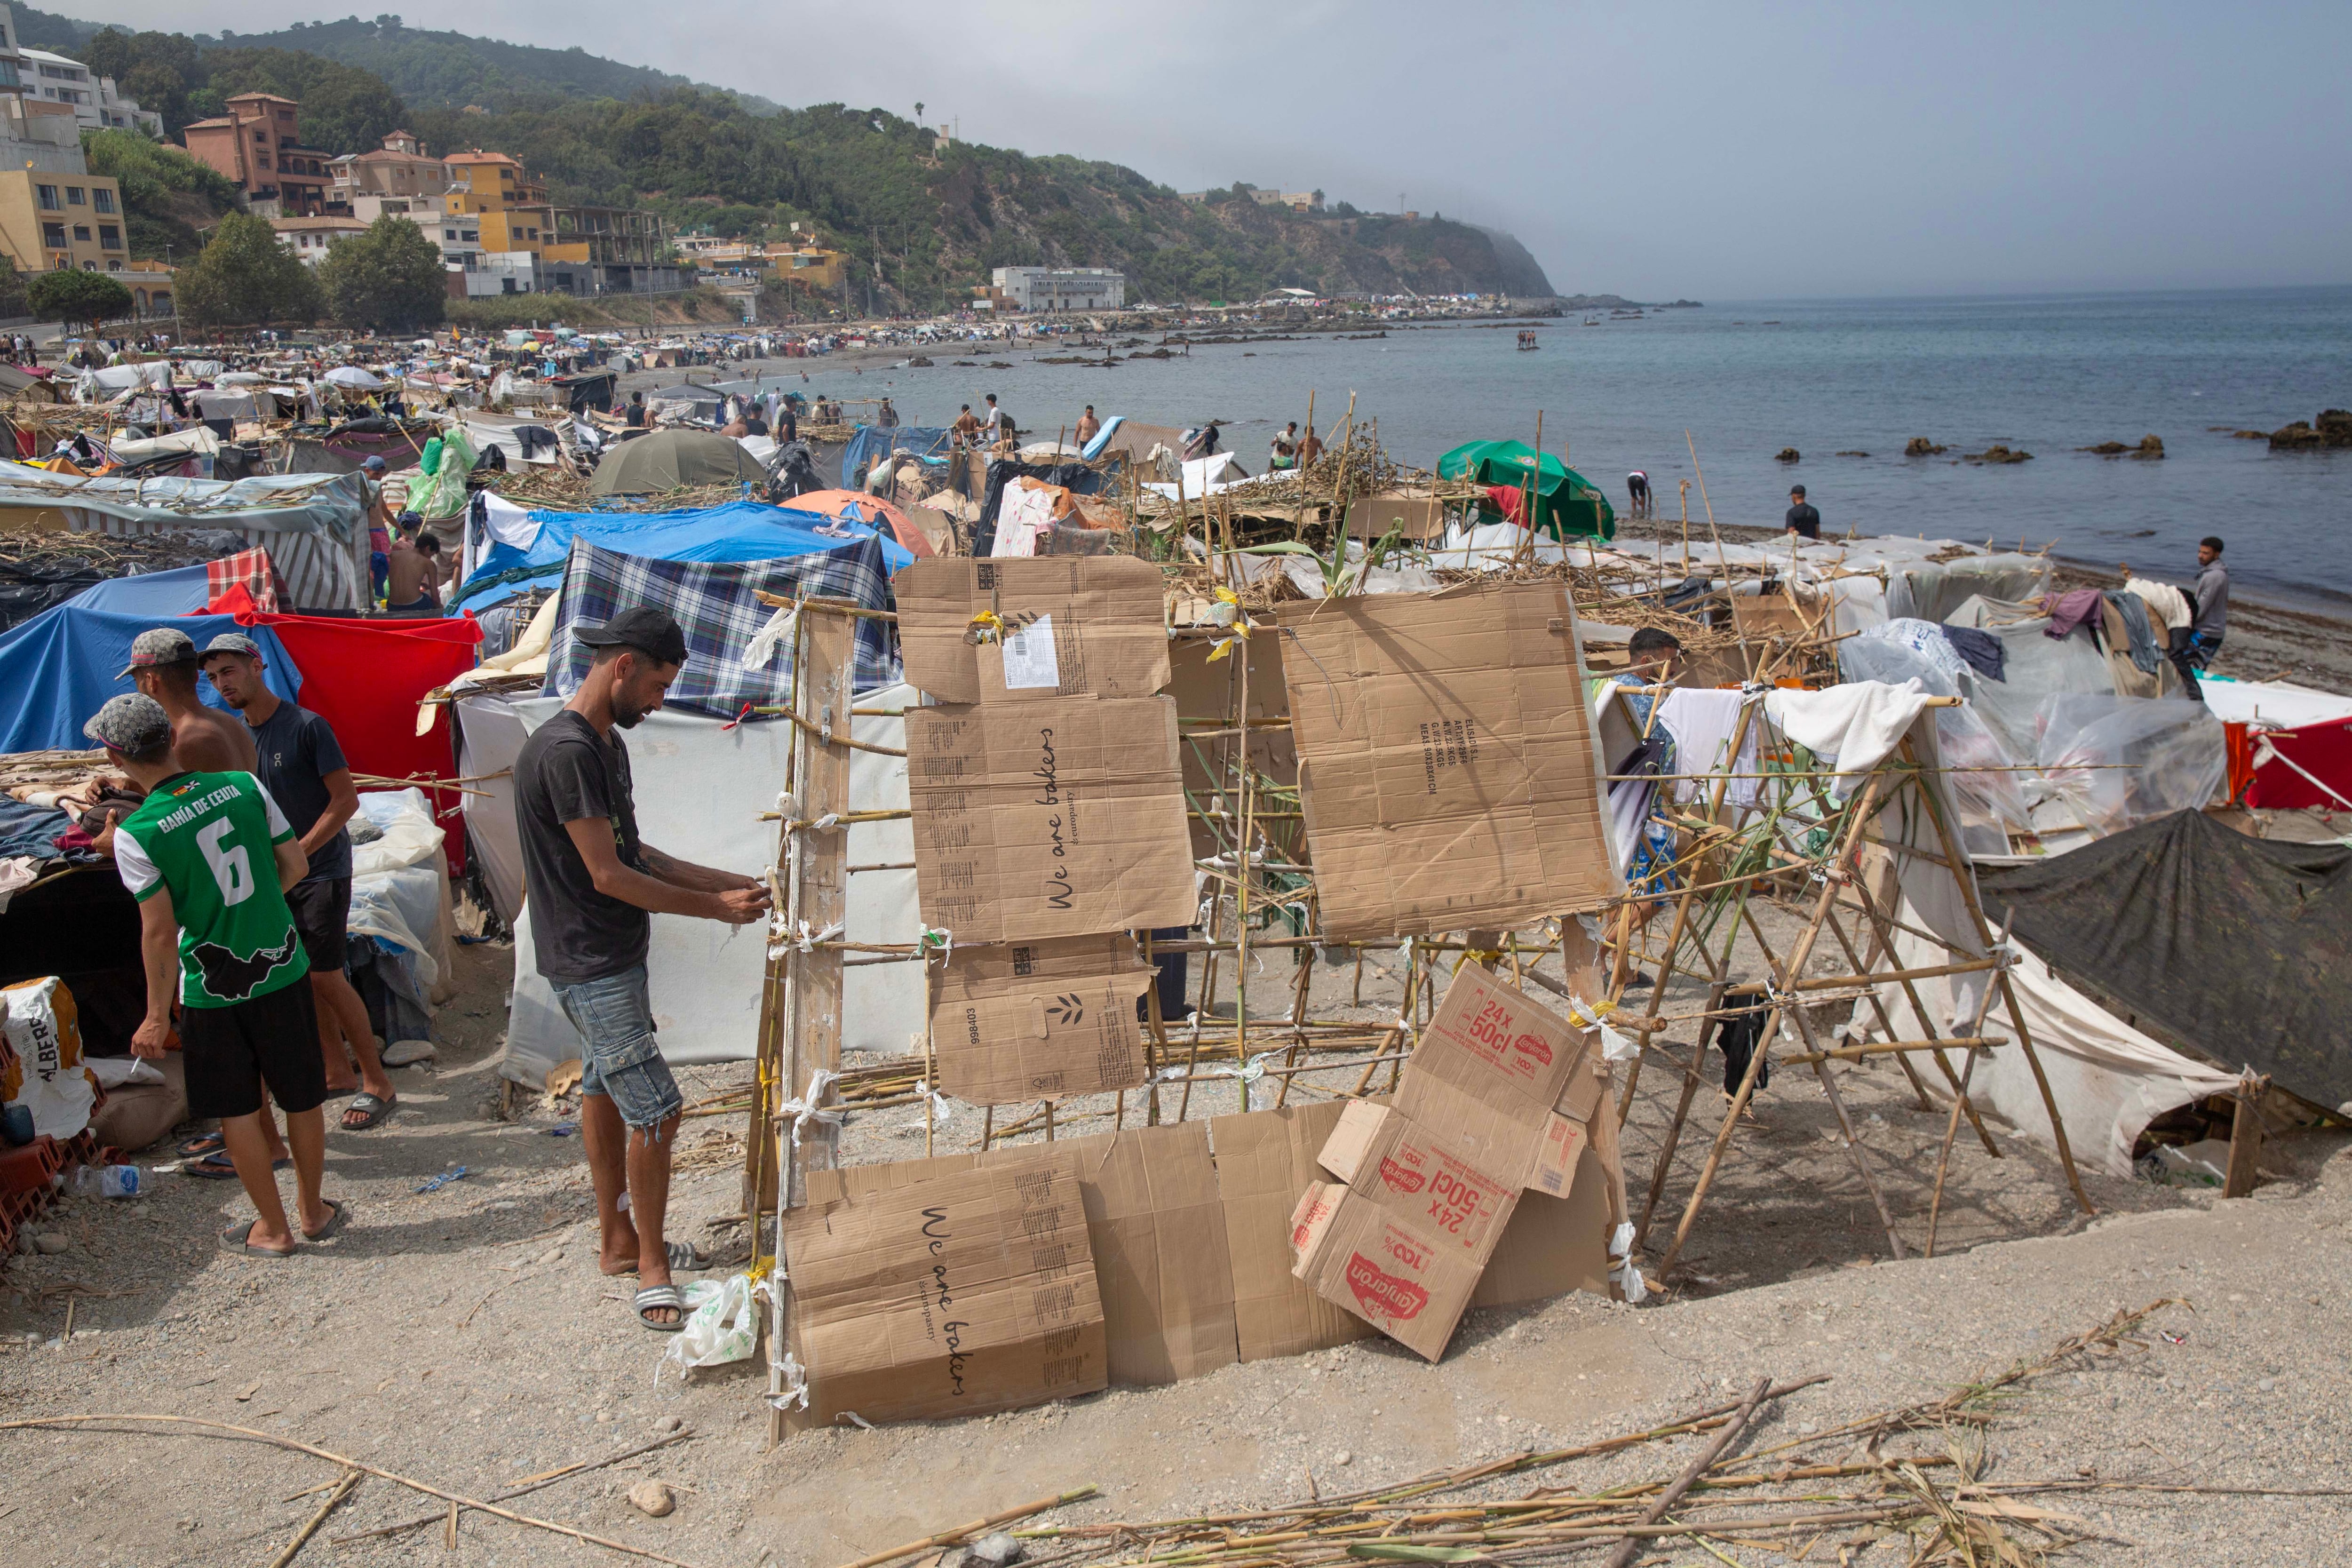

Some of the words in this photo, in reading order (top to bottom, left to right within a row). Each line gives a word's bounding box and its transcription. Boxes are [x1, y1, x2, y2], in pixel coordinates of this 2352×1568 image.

[1431, 722, 1445, 768] G.W.23.5KGS
[1443, 721, 1456, 766] N.W.22.5KGS
[1465, 719, 1477, 748] ELISADI
[1470, 748, 1478, 763] S.L.
[1033, 728, 1059, 805] bakers
[157, 805, 197, 834] BAHÍA
[191, 797, 211, 815] DE
[207, 785, 242, 807] CEUTA
[1067, 790, 1078, 836] europastry
[1049, 813, 1065, 857] are
[196, 816, 255, 907] 6
[1046, 865, 1073, 908] We
[966, 1008, 980, 1044] 998403
[1470, 1015, 1512, 1054] 50cl
[1519, 1036, 1550, 1060] Lanjarón
[1382, 1162, 1422, 1189] Lanjarón
[1428, 1170, 1479, 1215] 50cl
[922, 1207, 951, 1256] We
[933, 1266, 952, 1312] are
[1352, 1265, 1422, 1315] Lanjarón
[921, 1290, 936, 1341] europastry
[944, 1321, 973, 1396] bakers
